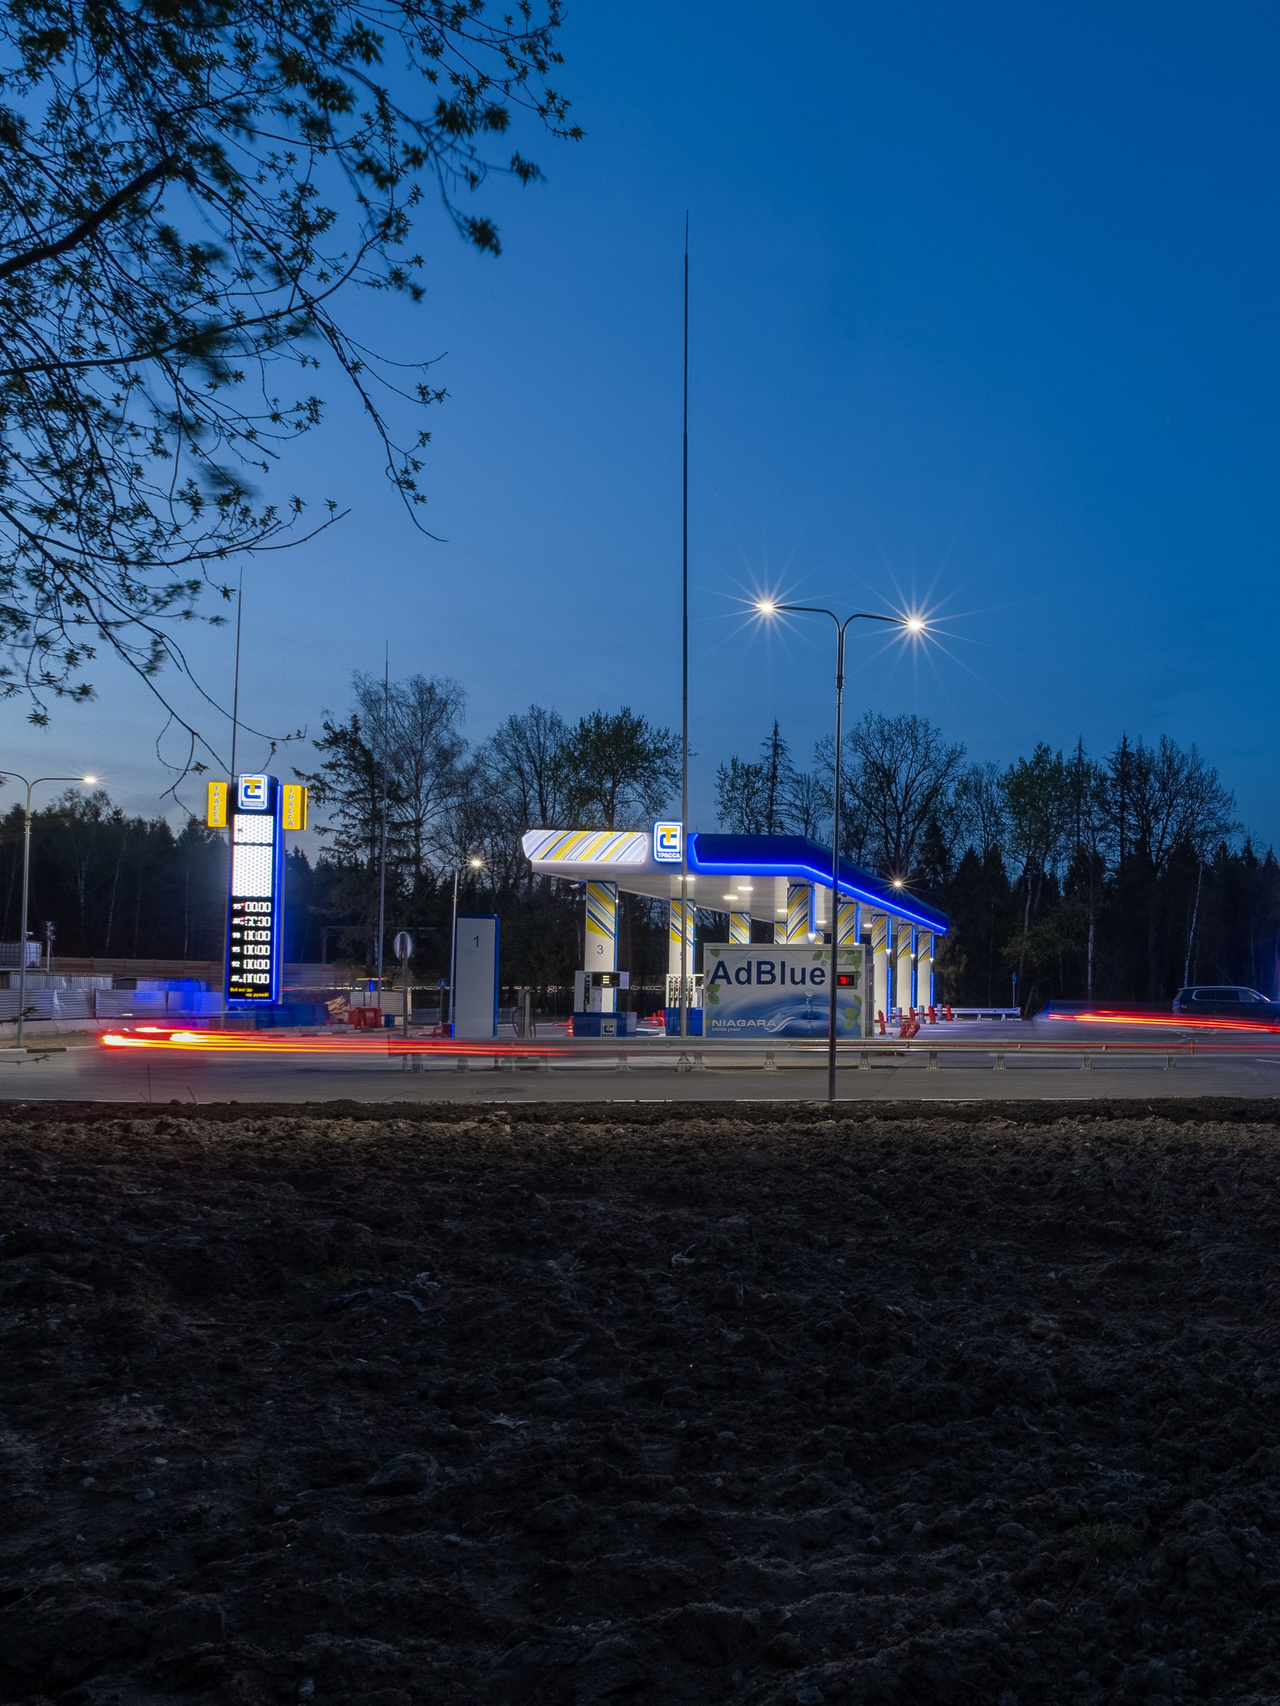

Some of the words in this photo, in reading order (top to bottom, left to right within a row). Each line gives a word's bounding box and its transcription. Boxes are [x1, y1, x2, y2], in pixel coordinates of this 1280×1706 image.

[213, 785, 221, 824] ТРАССА
[287, 788, 295, 826] ТРАССА
[473, 936, 480, 948] 1
[597, 945, 604, 955] 3
[709, 960, 826, 986] AdBlue
[711, 1019, 777, 1027] NIAGARA
